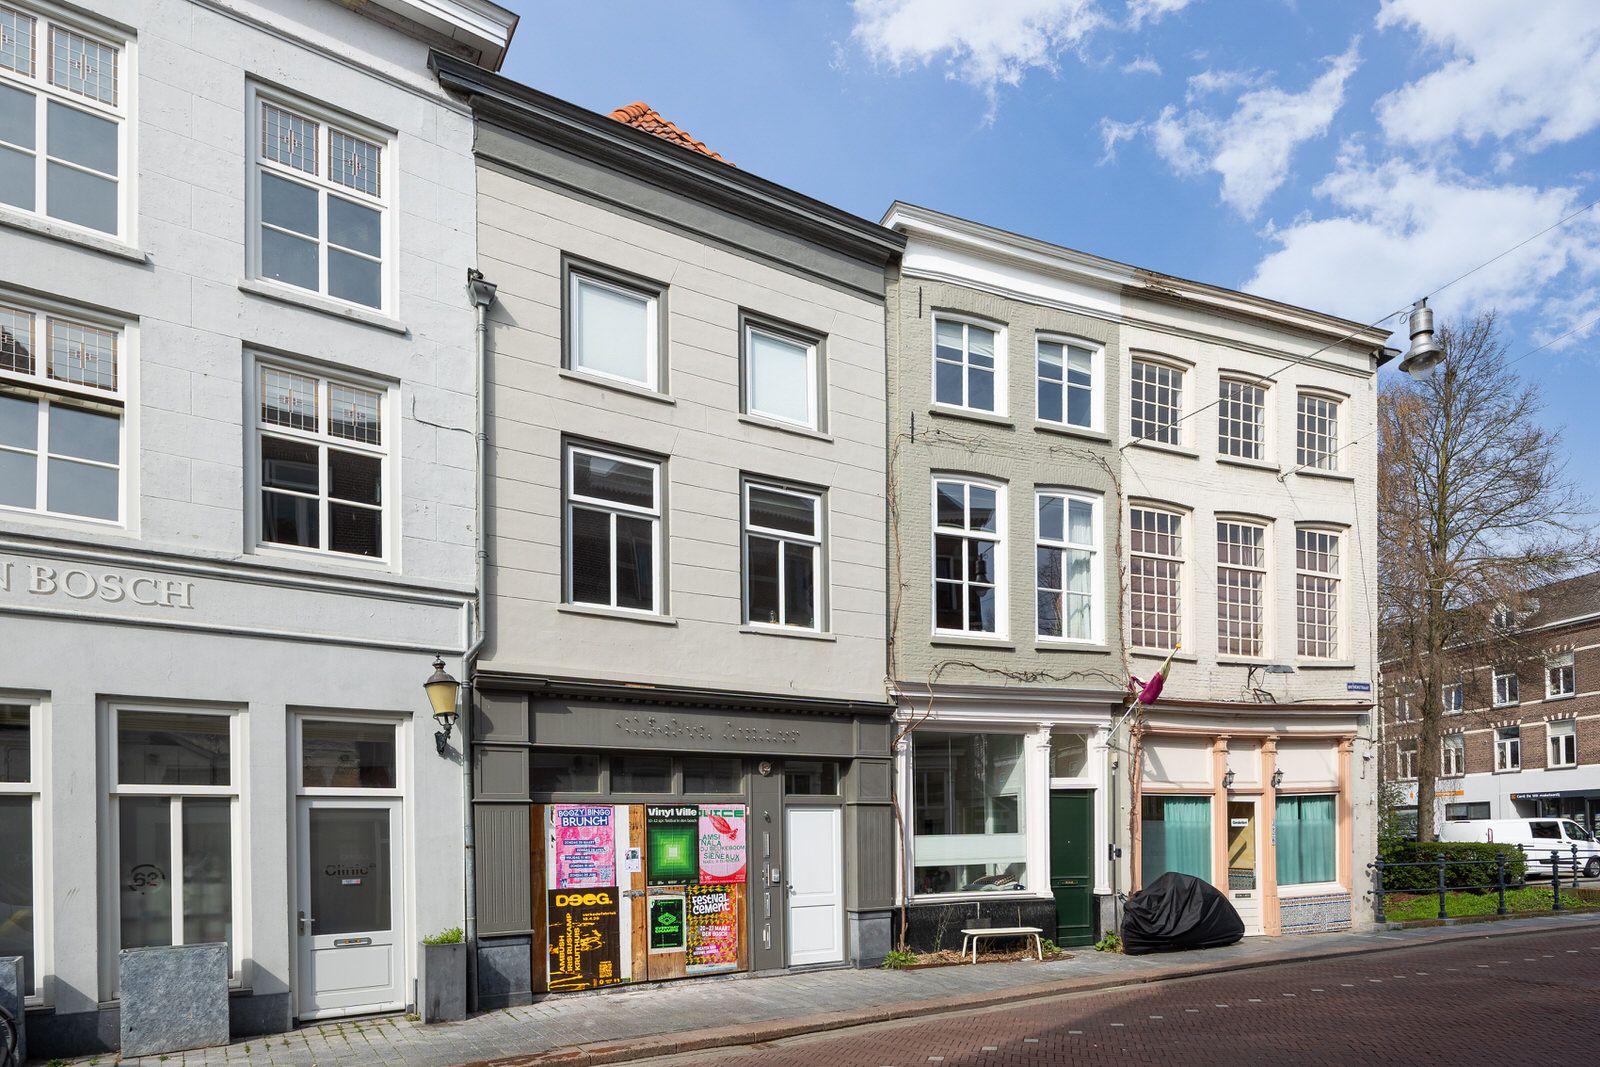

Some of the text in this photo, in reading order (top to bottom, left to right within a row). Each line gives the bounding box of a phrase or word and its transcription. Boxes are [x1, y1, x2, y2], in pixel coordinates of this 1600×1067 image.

[28, 565, 195, 609] BOSCH
[558, 808, 611, 817] BOOZY BINGO
[648, 807, 697, 818] Vinyl Ville
[562, 816, 608, 827] BRUNCH
